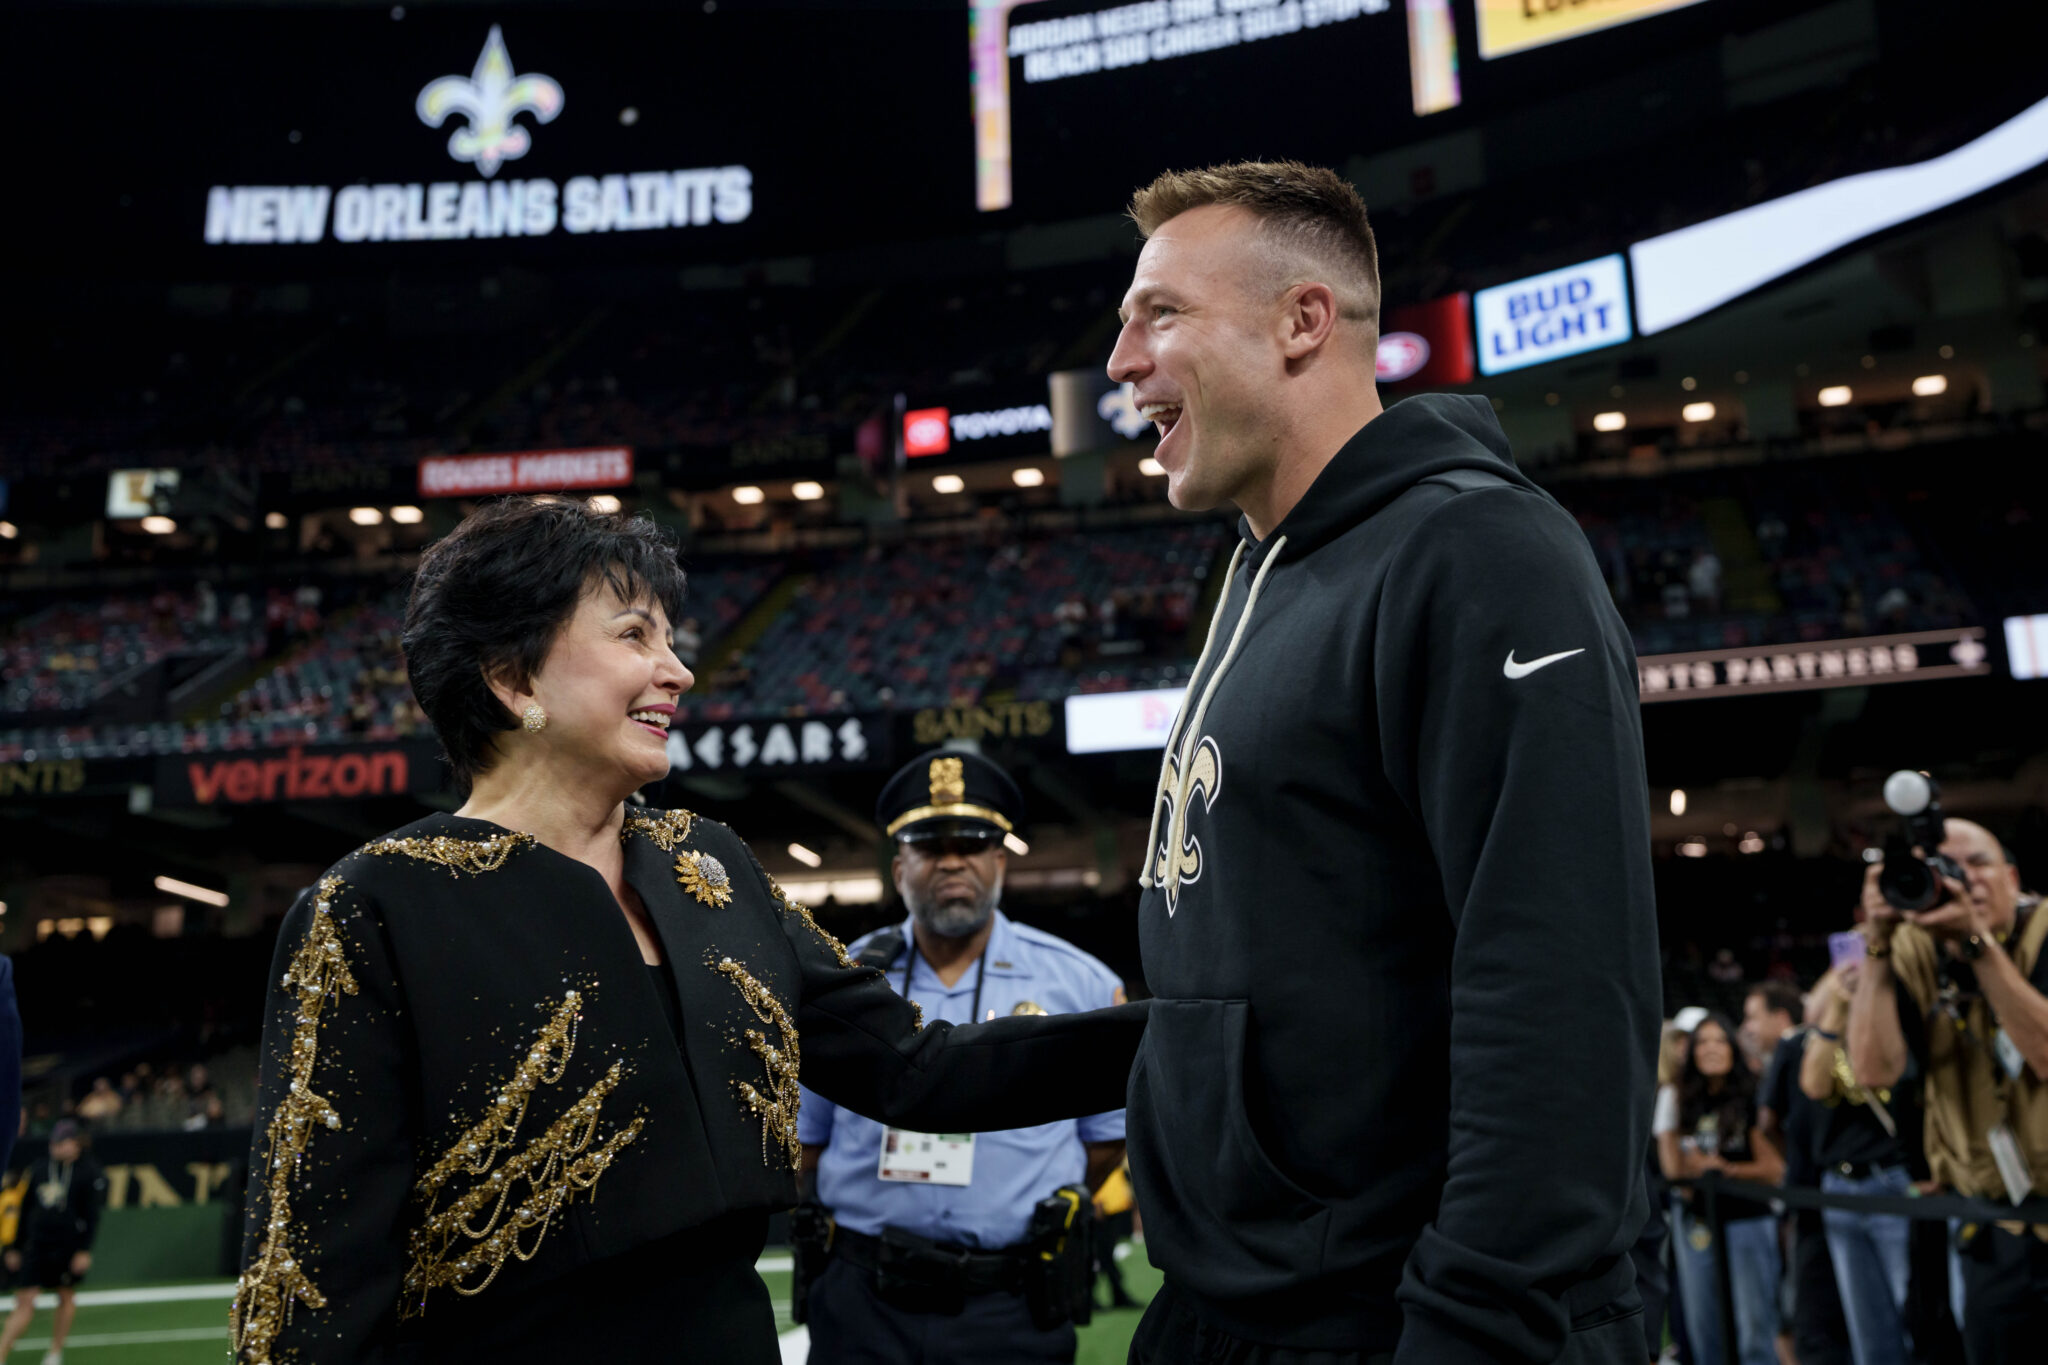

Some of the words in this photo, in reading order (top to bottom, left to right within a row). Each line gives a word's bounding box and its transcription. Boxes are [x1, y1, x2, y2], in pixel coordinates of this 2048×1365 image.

[205, 185, 331, 245] NEW
[332, 178, 557, 243] ORLEANS
[562, 165, 753, 233] SAINTS
[1507, 277, 1593, 321] BUD
[1493, 303, 1611, 357] LIGHT
[952, 404, 1053, 441] TOYOTA
[1640, 659, 1718, 693] NTS
[1724, 643, 1919, 686] PARTNERS
[912, 700, 1053, 745] SAINTS
[0, 759, 84, 797] NTS
[188, 746, 409, 804] verizon
